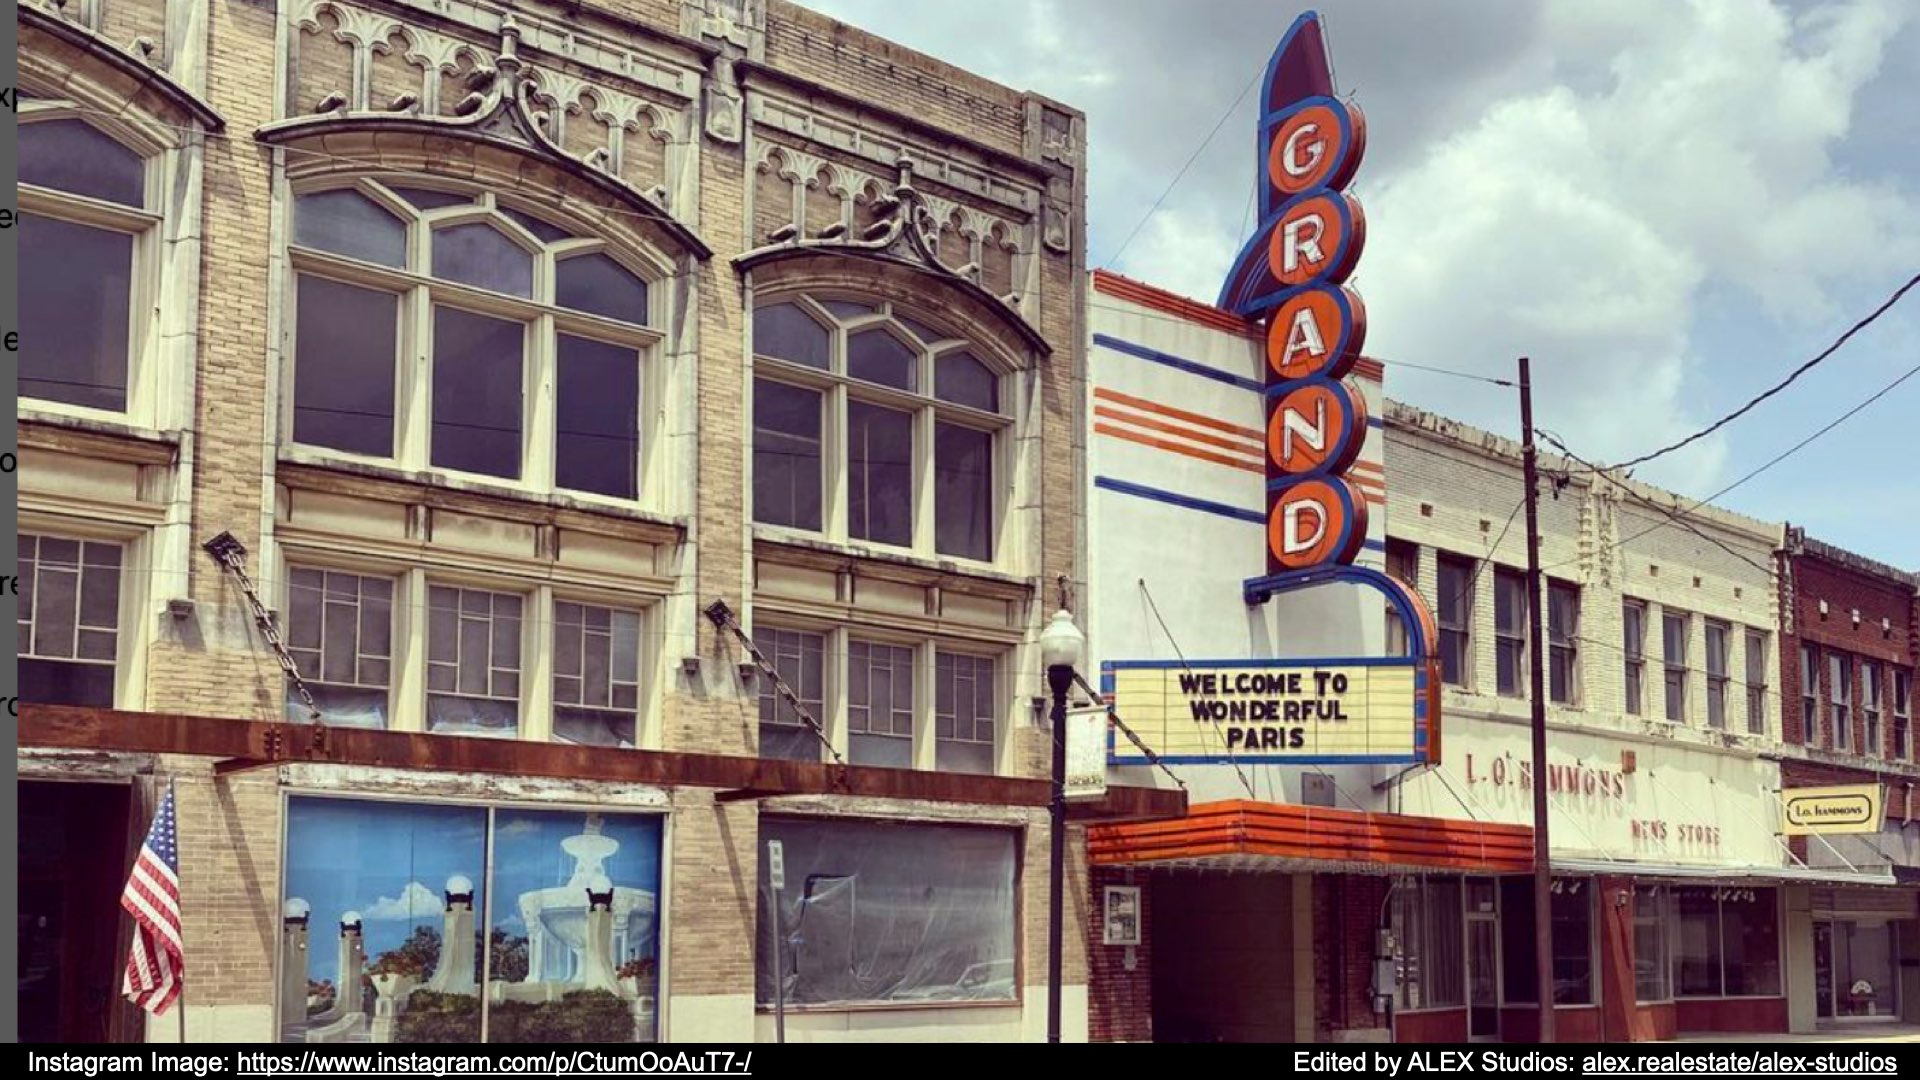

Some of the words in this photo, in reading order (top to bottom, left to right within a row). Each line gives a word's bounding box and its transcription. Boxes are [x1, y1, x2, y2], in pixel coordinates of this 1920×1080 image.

[1282, 122, 1329, 556] GRAND
[1179, 672, 1301, 695] WELCOME
[1313, 671, 1348, 696] TO
[1190, 700, 1348, 722] WONDERFUL
[1226, 726, 1305, 749] PARIS
[1520, 759, 1624, 799] HMMONS
[1677, 823, 1720, 846] STORE
